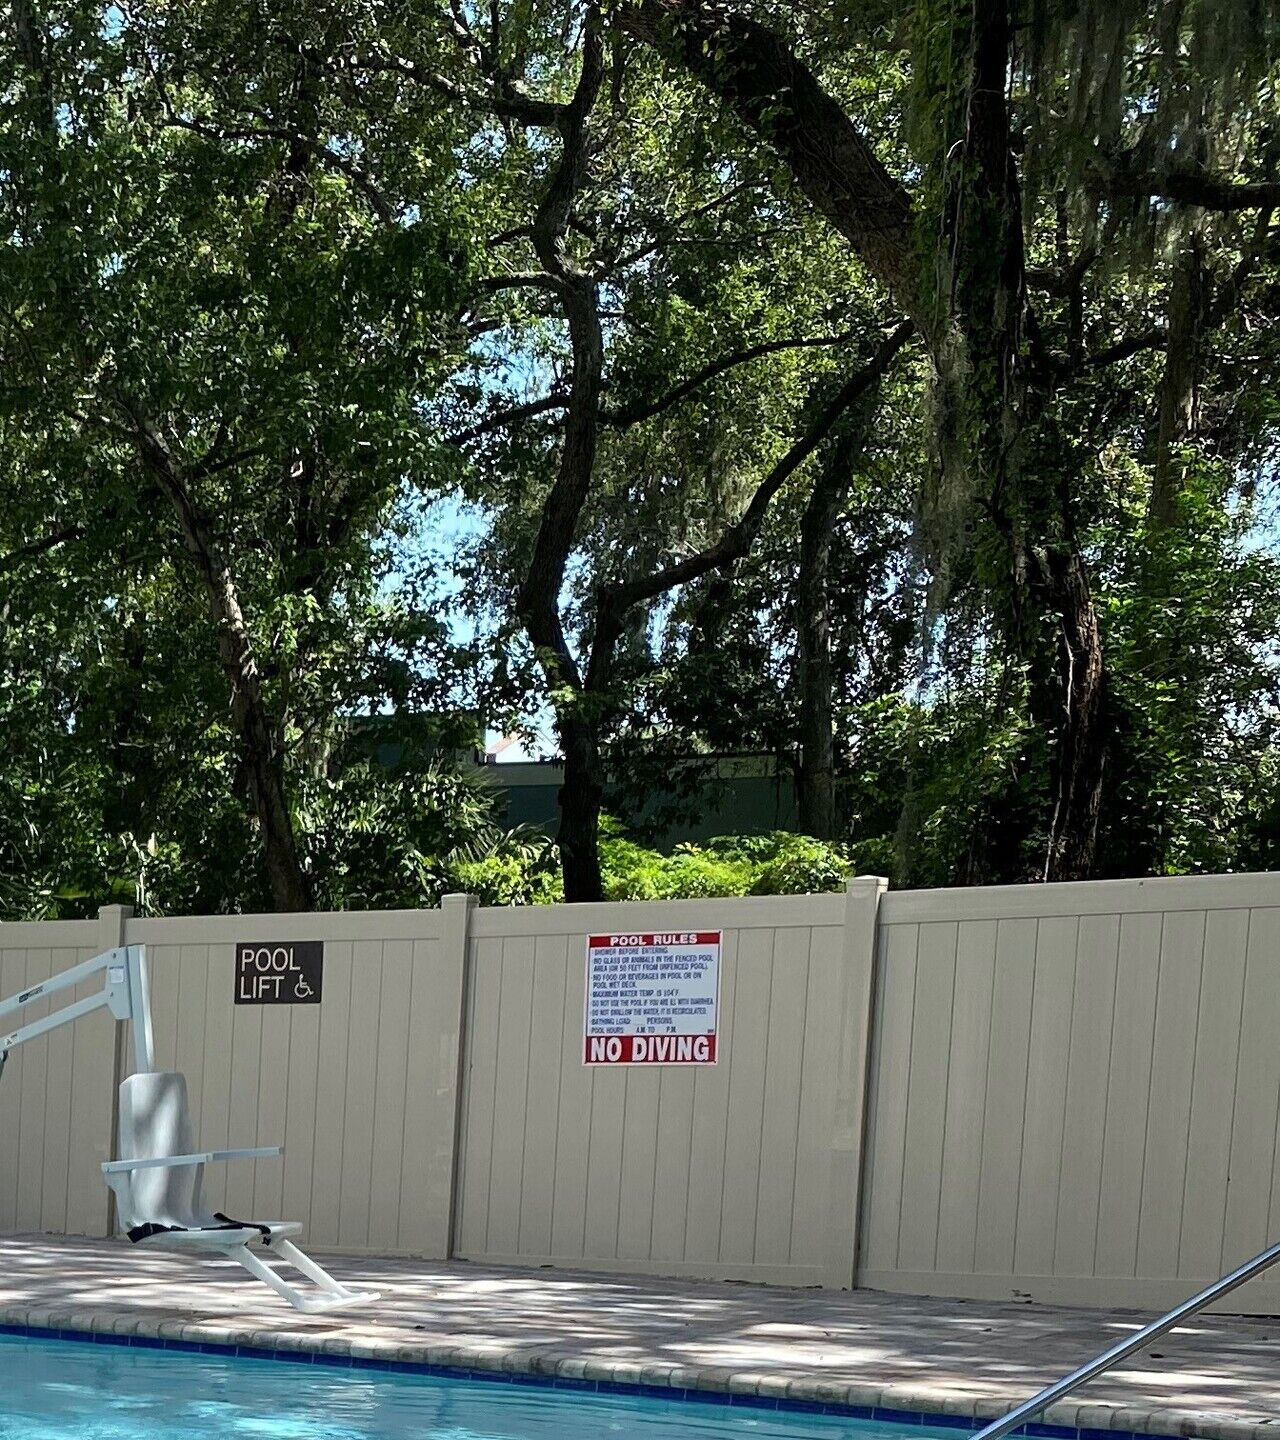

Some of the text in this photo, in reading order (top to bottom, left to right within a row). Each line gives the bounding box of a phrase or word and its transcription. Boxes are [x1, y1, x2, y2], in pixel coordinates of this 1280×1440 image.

[610, 935, 697, 945] POOL RULES
[242, 948, 301, 972] POOL
[240, 976, 285, 999] LIFT
[591, 1036, 709, 1061] NO DIVING
